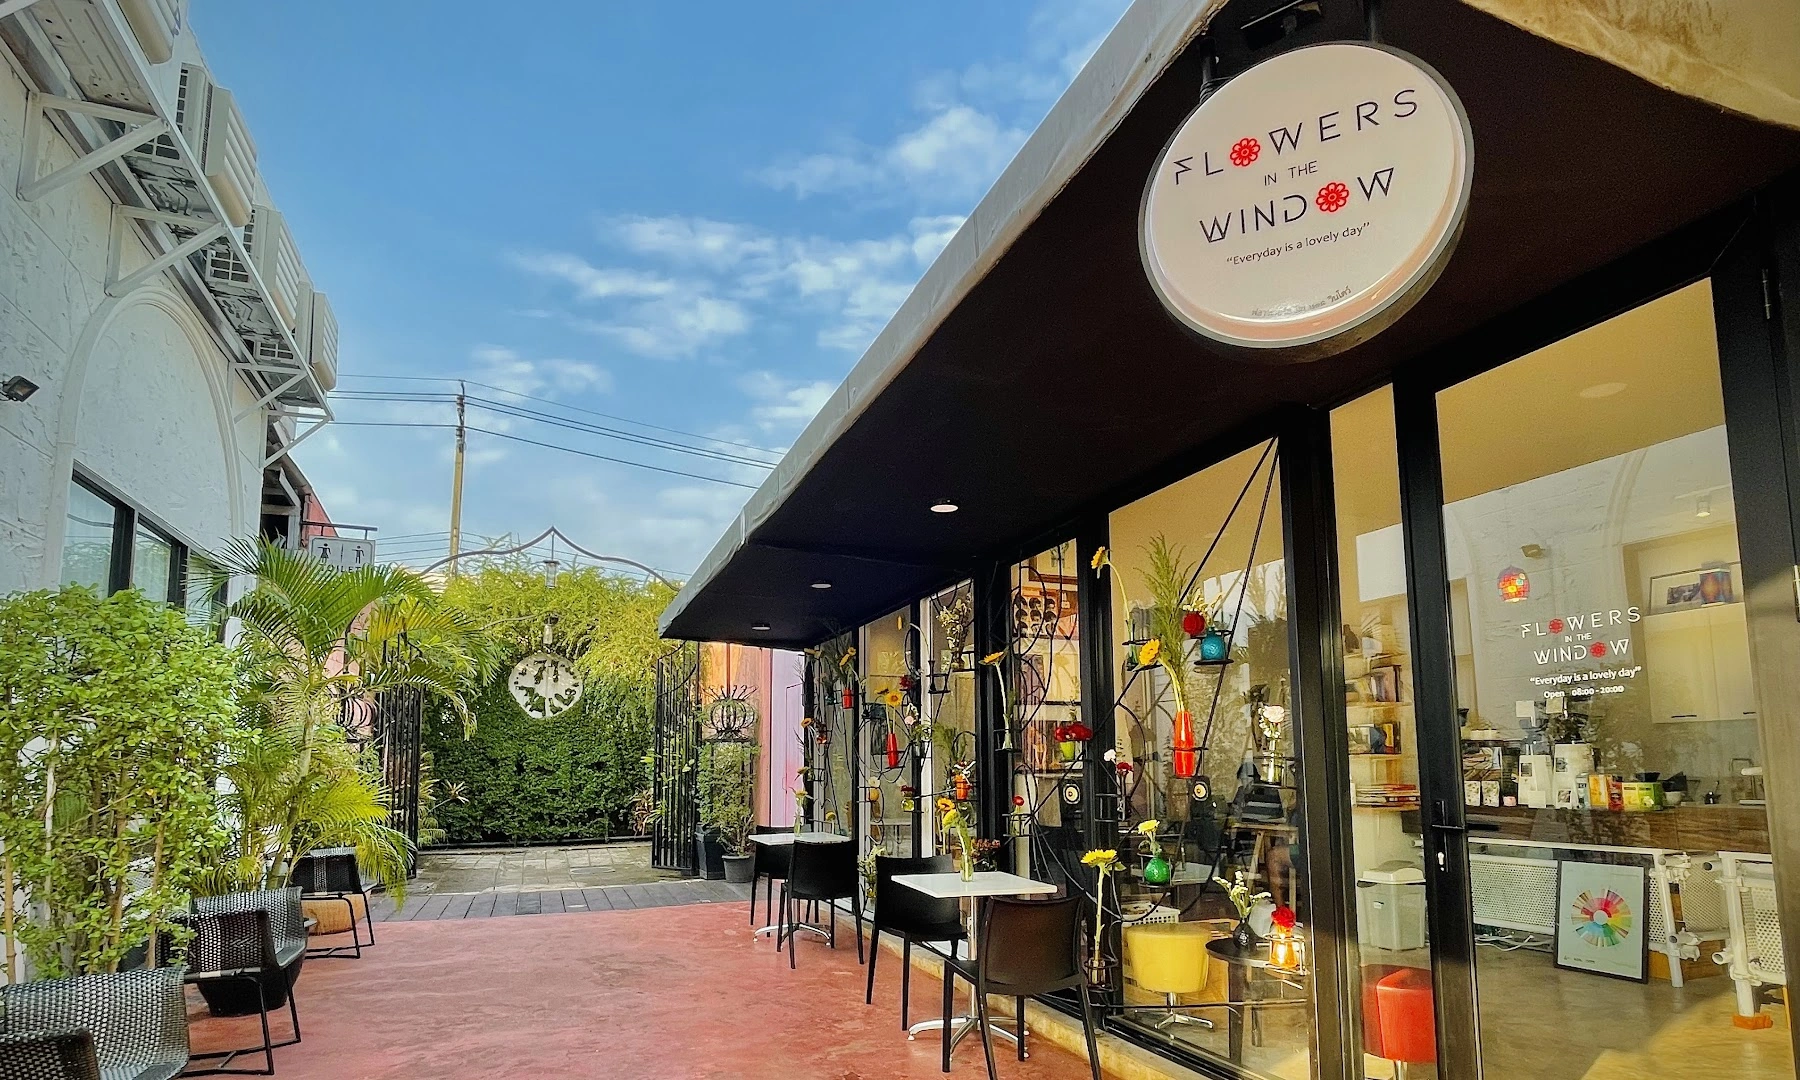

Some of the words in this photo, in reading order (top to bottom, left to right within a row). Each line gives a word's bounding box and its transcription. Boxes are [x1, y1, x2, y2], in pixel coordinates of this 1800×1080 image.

[1173, 89, 1418, 185] FLOWERS
[1263, 172, 1277, 186] IN
[1288, 160, 1318, 179] THE
[1199, 168, 1394, 243] WINDOW
[1285, 243, 1293, 252] is
[1296, 241, 1303, 249] a
[1306, 232, 1339, 247] lovely
[318, 563, 361, 574] TOILET
[1520, 606, 1641, 639] FLOWERS
[1564, 635, 1573, 643] IN
[1576, 632, 1592, 641] THE
[1533, 638, 1630, 665] WINDOW
[1573, 673, 1581, 682] is
[1582, 673, 1589, 681] a
[1589, 668, 1617, 680] lovely
[1543, 690, 1566, 700] Open
[1571, 687, 1595, 697] 08:00
[1600, 685, 1625, 694] 20:00
